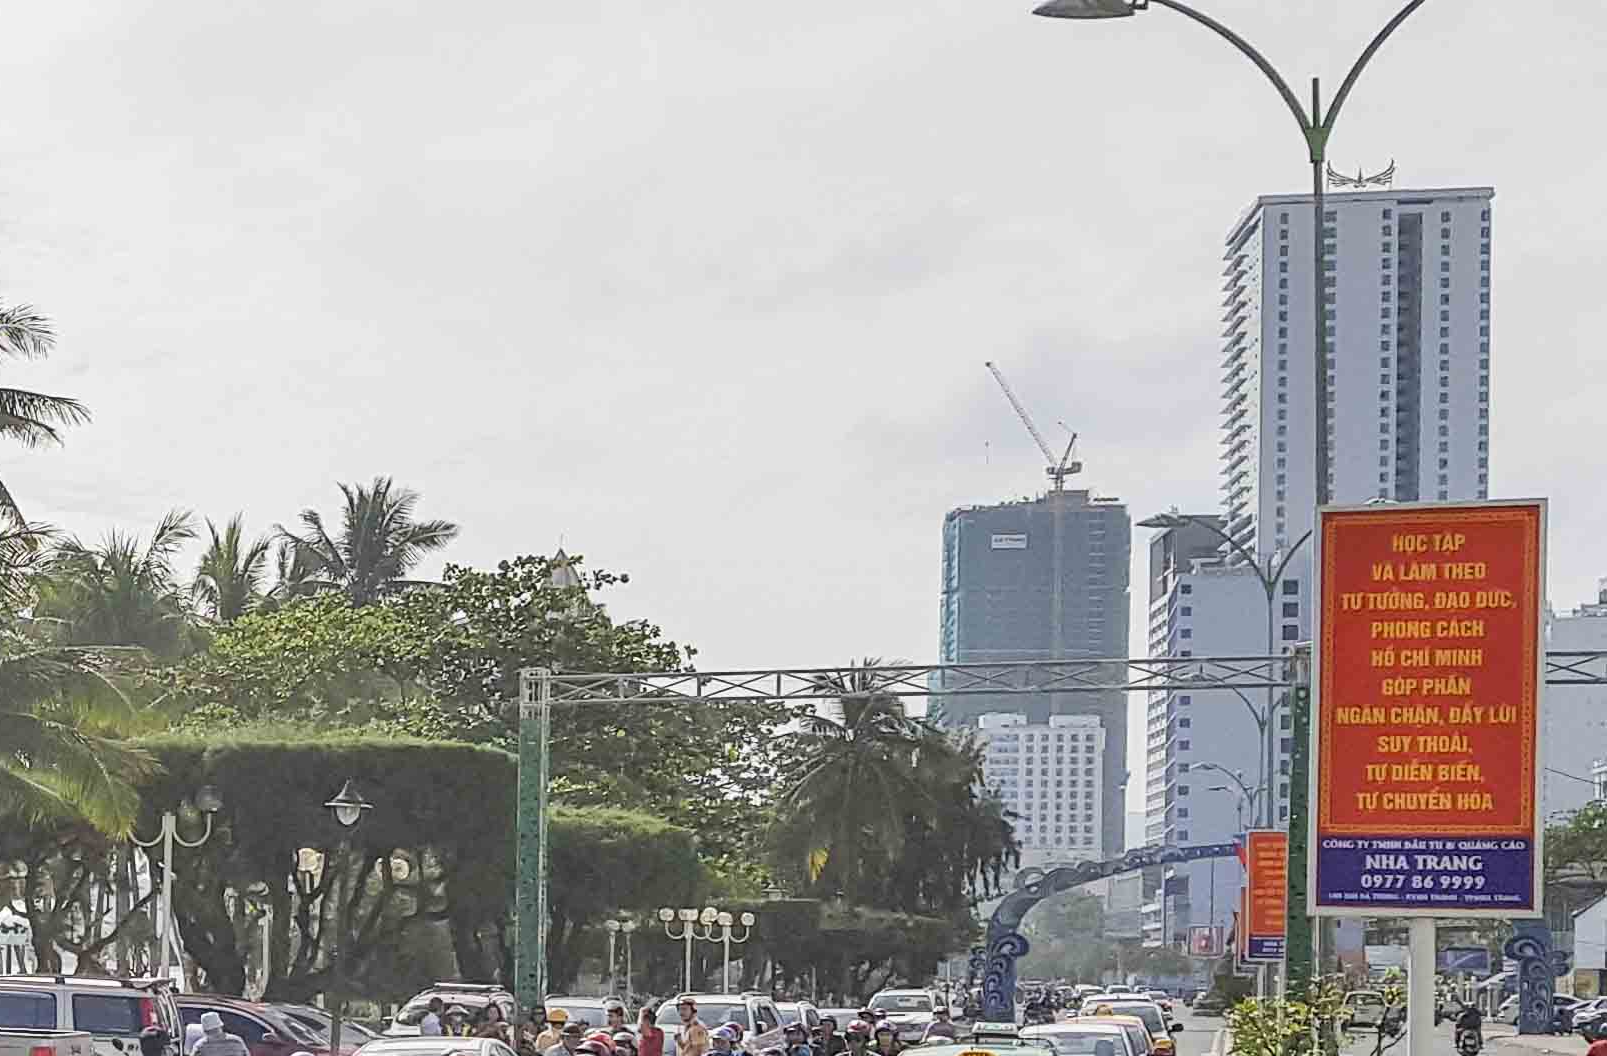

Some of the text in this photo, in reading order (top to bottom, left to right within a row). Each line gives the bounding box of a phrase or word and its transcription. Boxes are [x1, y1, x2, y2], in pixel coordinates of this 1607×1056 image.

[1444, 562, 1486, 580] THEO
[1371, 617, 1484, 638] PHONG CÁCH
[1400, 645, 1430, 666] CHÍ
[1435, 649, 1483, 666] MINH
[1377, 735, 1412, 752] SUY
[1365, 854, 1483, 870] NHA TRANG
[1360, 874, 1486, 889] 0977 86 9999
